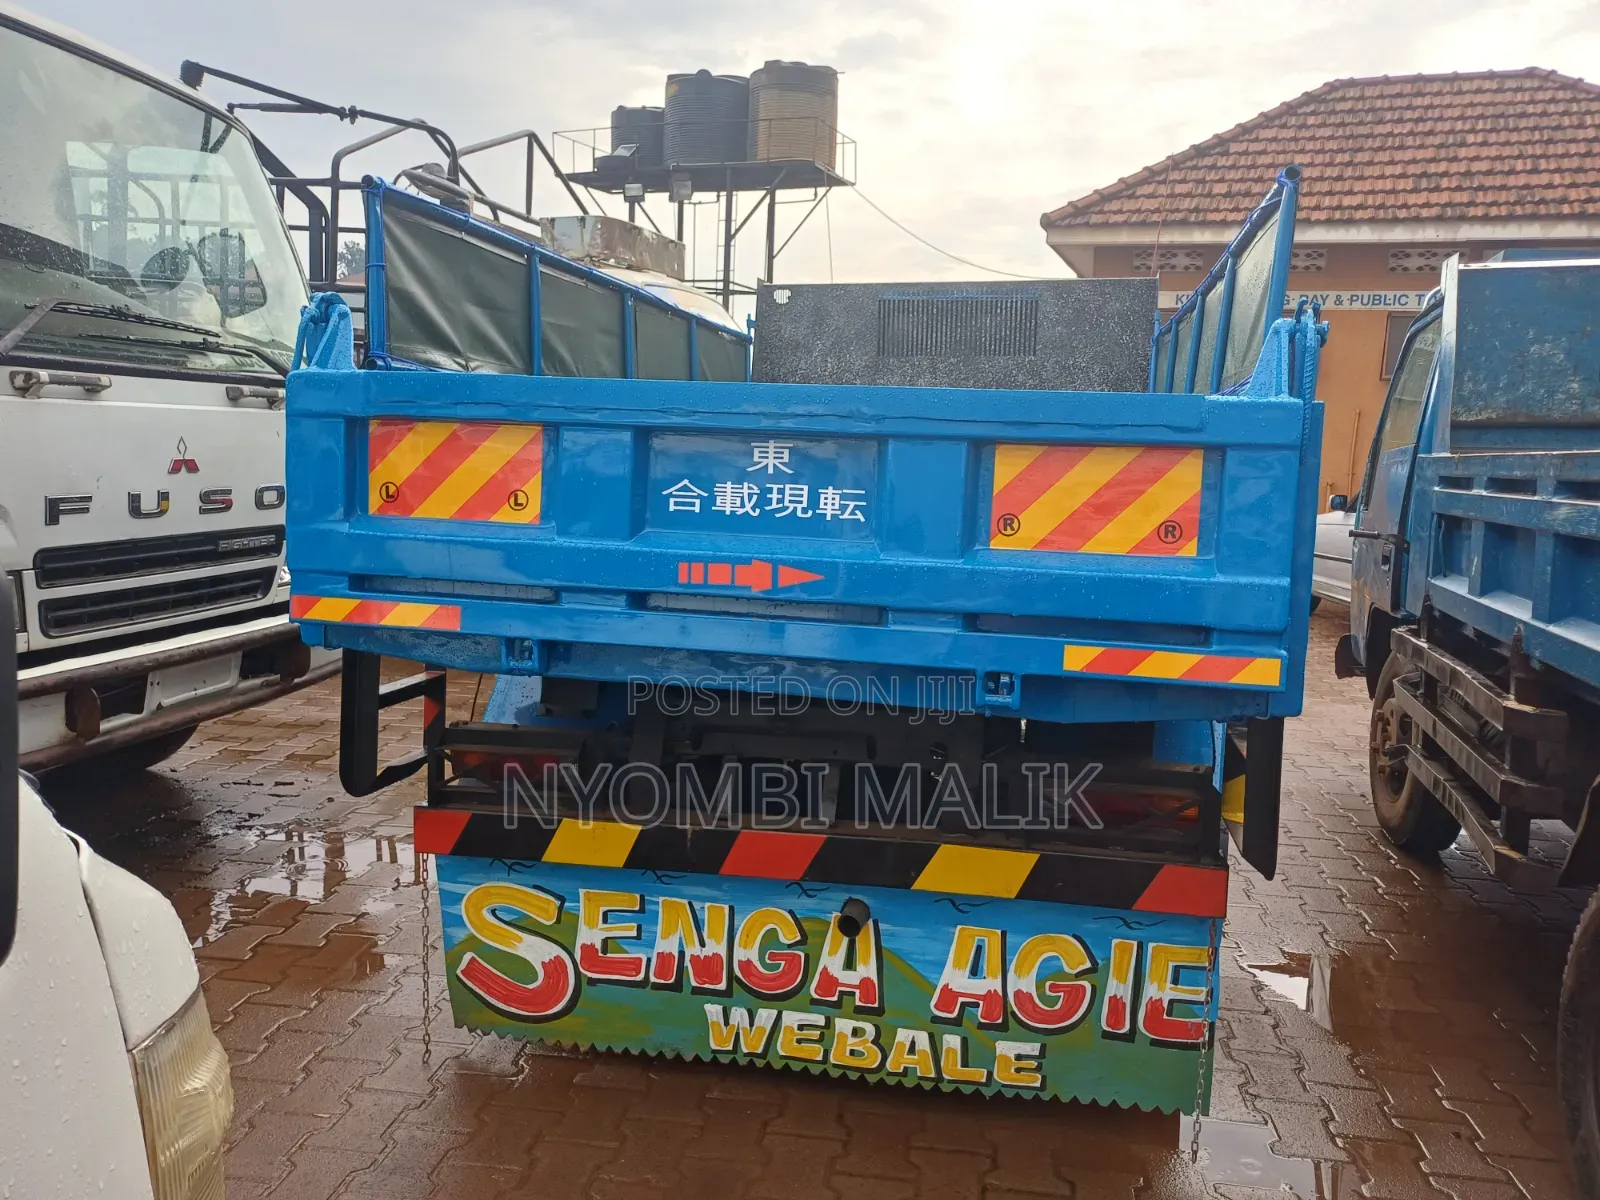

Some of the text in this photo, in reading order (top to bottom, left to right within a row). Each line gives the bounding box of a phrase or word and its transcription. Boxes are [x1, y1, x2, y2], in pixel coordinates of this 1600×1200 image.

[1333, 294, 1344, 306] &
[1350, 294, 1409, 306] PUBLIC
[746, 440, 795, 474] 東
[44, 483, 286, 526] FUSO
[661, 479, 867, 522] 合載現転
[456, 881, 1211, 1048] SENGA AGIE
[704, 1003, 1047, 1090] WEBALE
